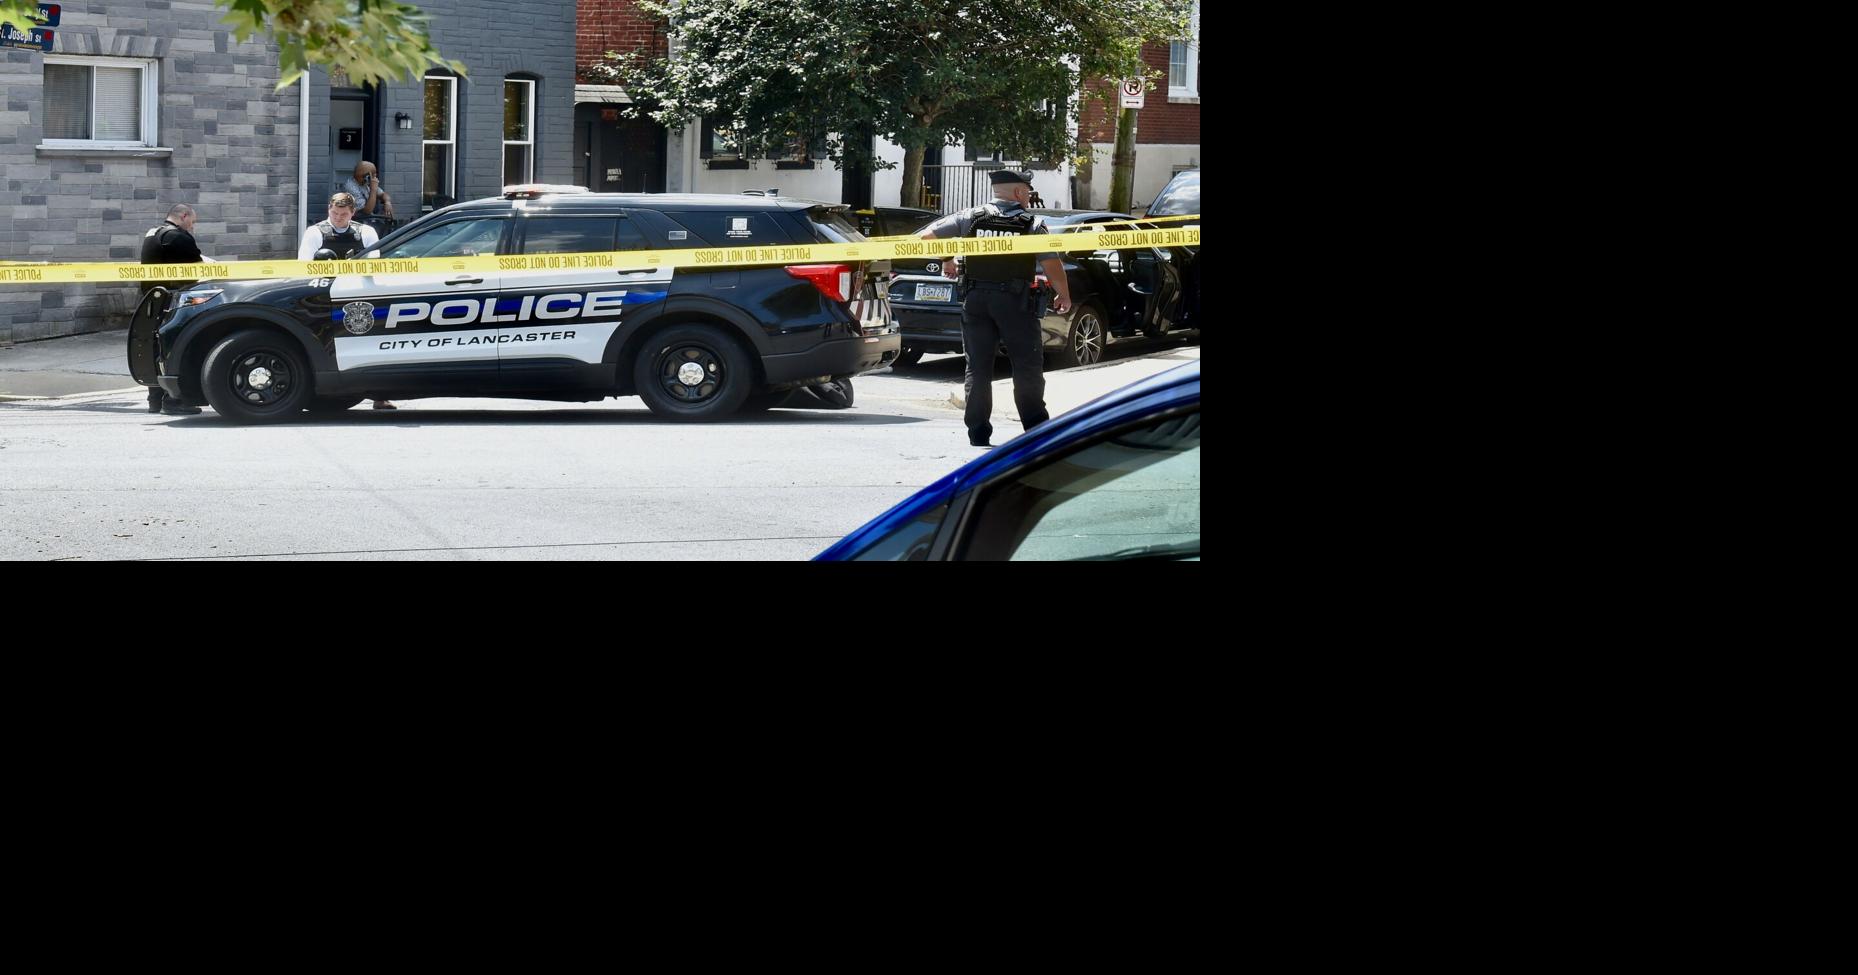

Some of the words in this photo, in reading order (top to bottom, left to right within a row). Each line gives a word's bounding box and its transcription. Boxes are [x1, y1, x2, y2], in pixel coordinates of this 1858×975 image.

[8, 27, 33, 43] Joseph
[346, 134, 352, 142] 3
[1098, 234, 1128, 247] CROSS
[1131, 233, 1149, 246] NOT
[1151, 232, 1163, 245] DO
[1166, 231, 1185, 244] LINE
[894, 243, 924, 256] CROSS
[926, 243, 944, 254] NOT
[946, 241, 959, 253] DO
[961, 240, 979, 253] LINE
[984, 239, 1013, 252] POLICE
[694, 251, 724, 263] CROSS
[725, 250, 743, 262] NOT
[745, 250, 757, 262] DO
[759, 249, 778, 261] LINE
[782, 248, 811, 261] POLICE
[390, 261, 419, 272] POLICE
[499, 258, 527, 270] CROSS
[530, 257, 547, 269] NOT
[549, 257, 560, 268] DO
[562, 256, 581, 268] LINE
[583, 255, 613, 267] POLICE
[119, 267, 146, 278] CROSS
[149, 267, 165, 278] NOT
[166, 266, 178, 277] DO
[180, 266, 198, 277] LINE
[200, 266, 228, 276] POLICE
[307, 264, 335, 275] CROSS
[337, 263, 354, 274] NOT
[356, 262, 367, 273] DO
[369, 262, 387, 273] LINE
[14, 269, 42, 280] POLICE
[308, 278, 331, 288] 46
[384, 290, 627, 329] POLICE
[379, 339, 422, 350] CITY
[427, 337, 452, 348] OF
[457, 330, 576, 346] LANCASTER
